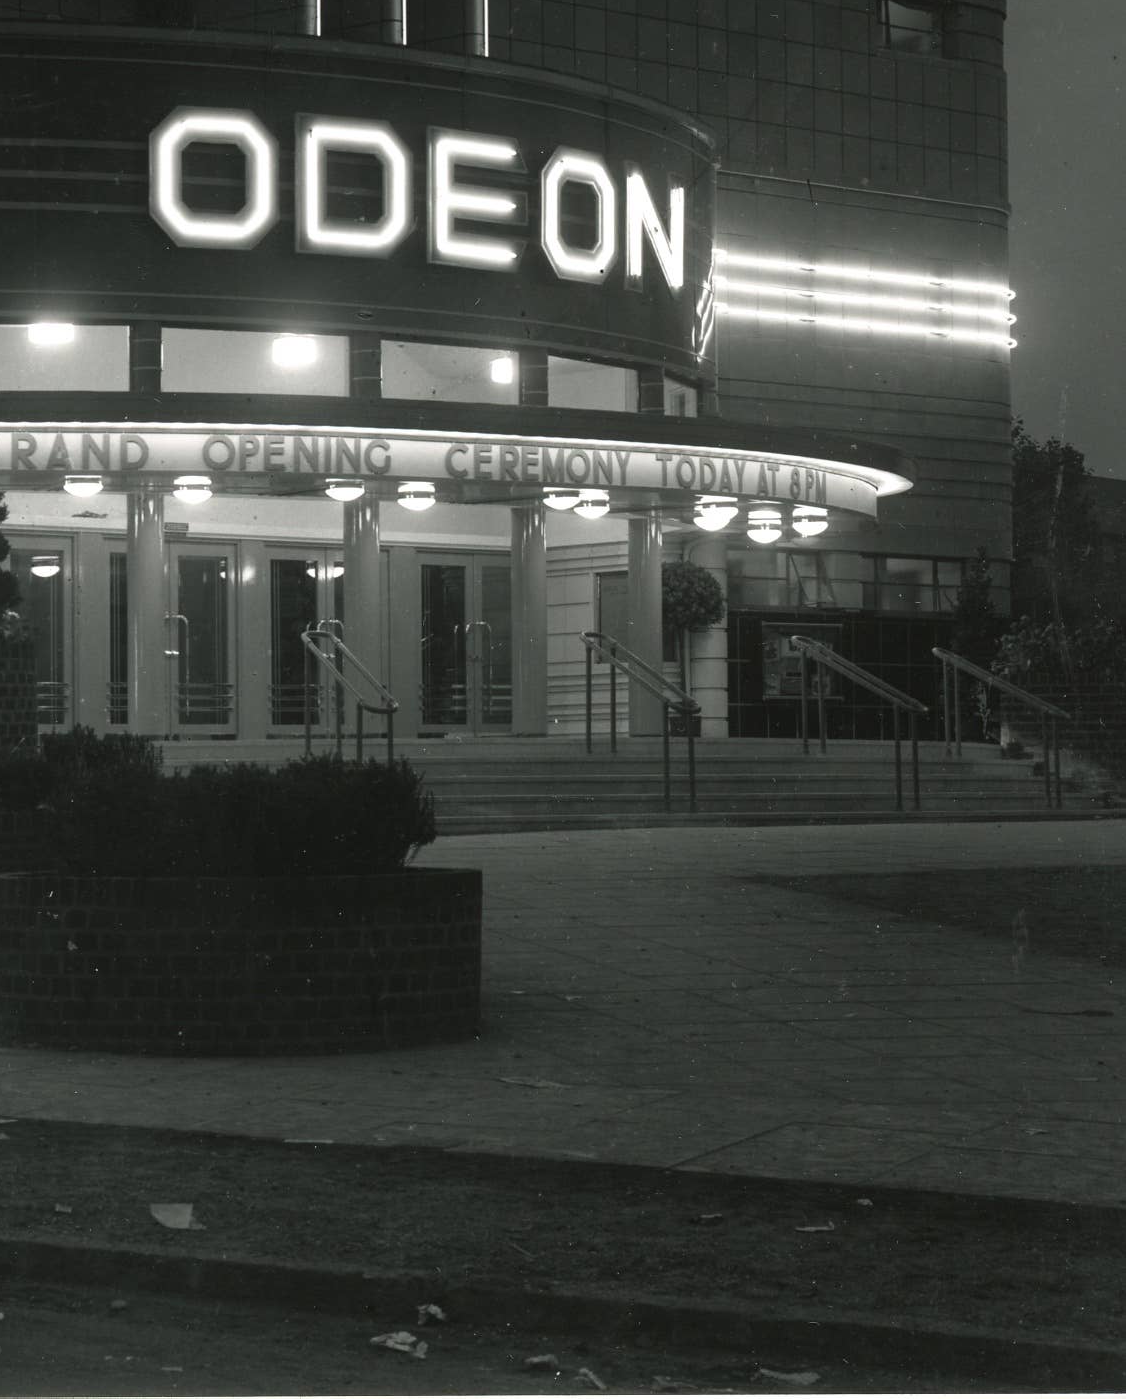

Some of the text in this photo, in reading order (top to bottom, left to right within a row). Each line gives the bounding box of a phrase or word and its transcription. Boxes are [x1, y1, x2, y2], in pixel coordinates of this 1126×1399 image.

[151, 107, 685, 292] ODEON
[202, 434, 392, 475] OPENING
[445, 443, 631, 487] CEREMONY
[656, 453, 746, 495] TODAY
[756, 462, 780, 497] AT
